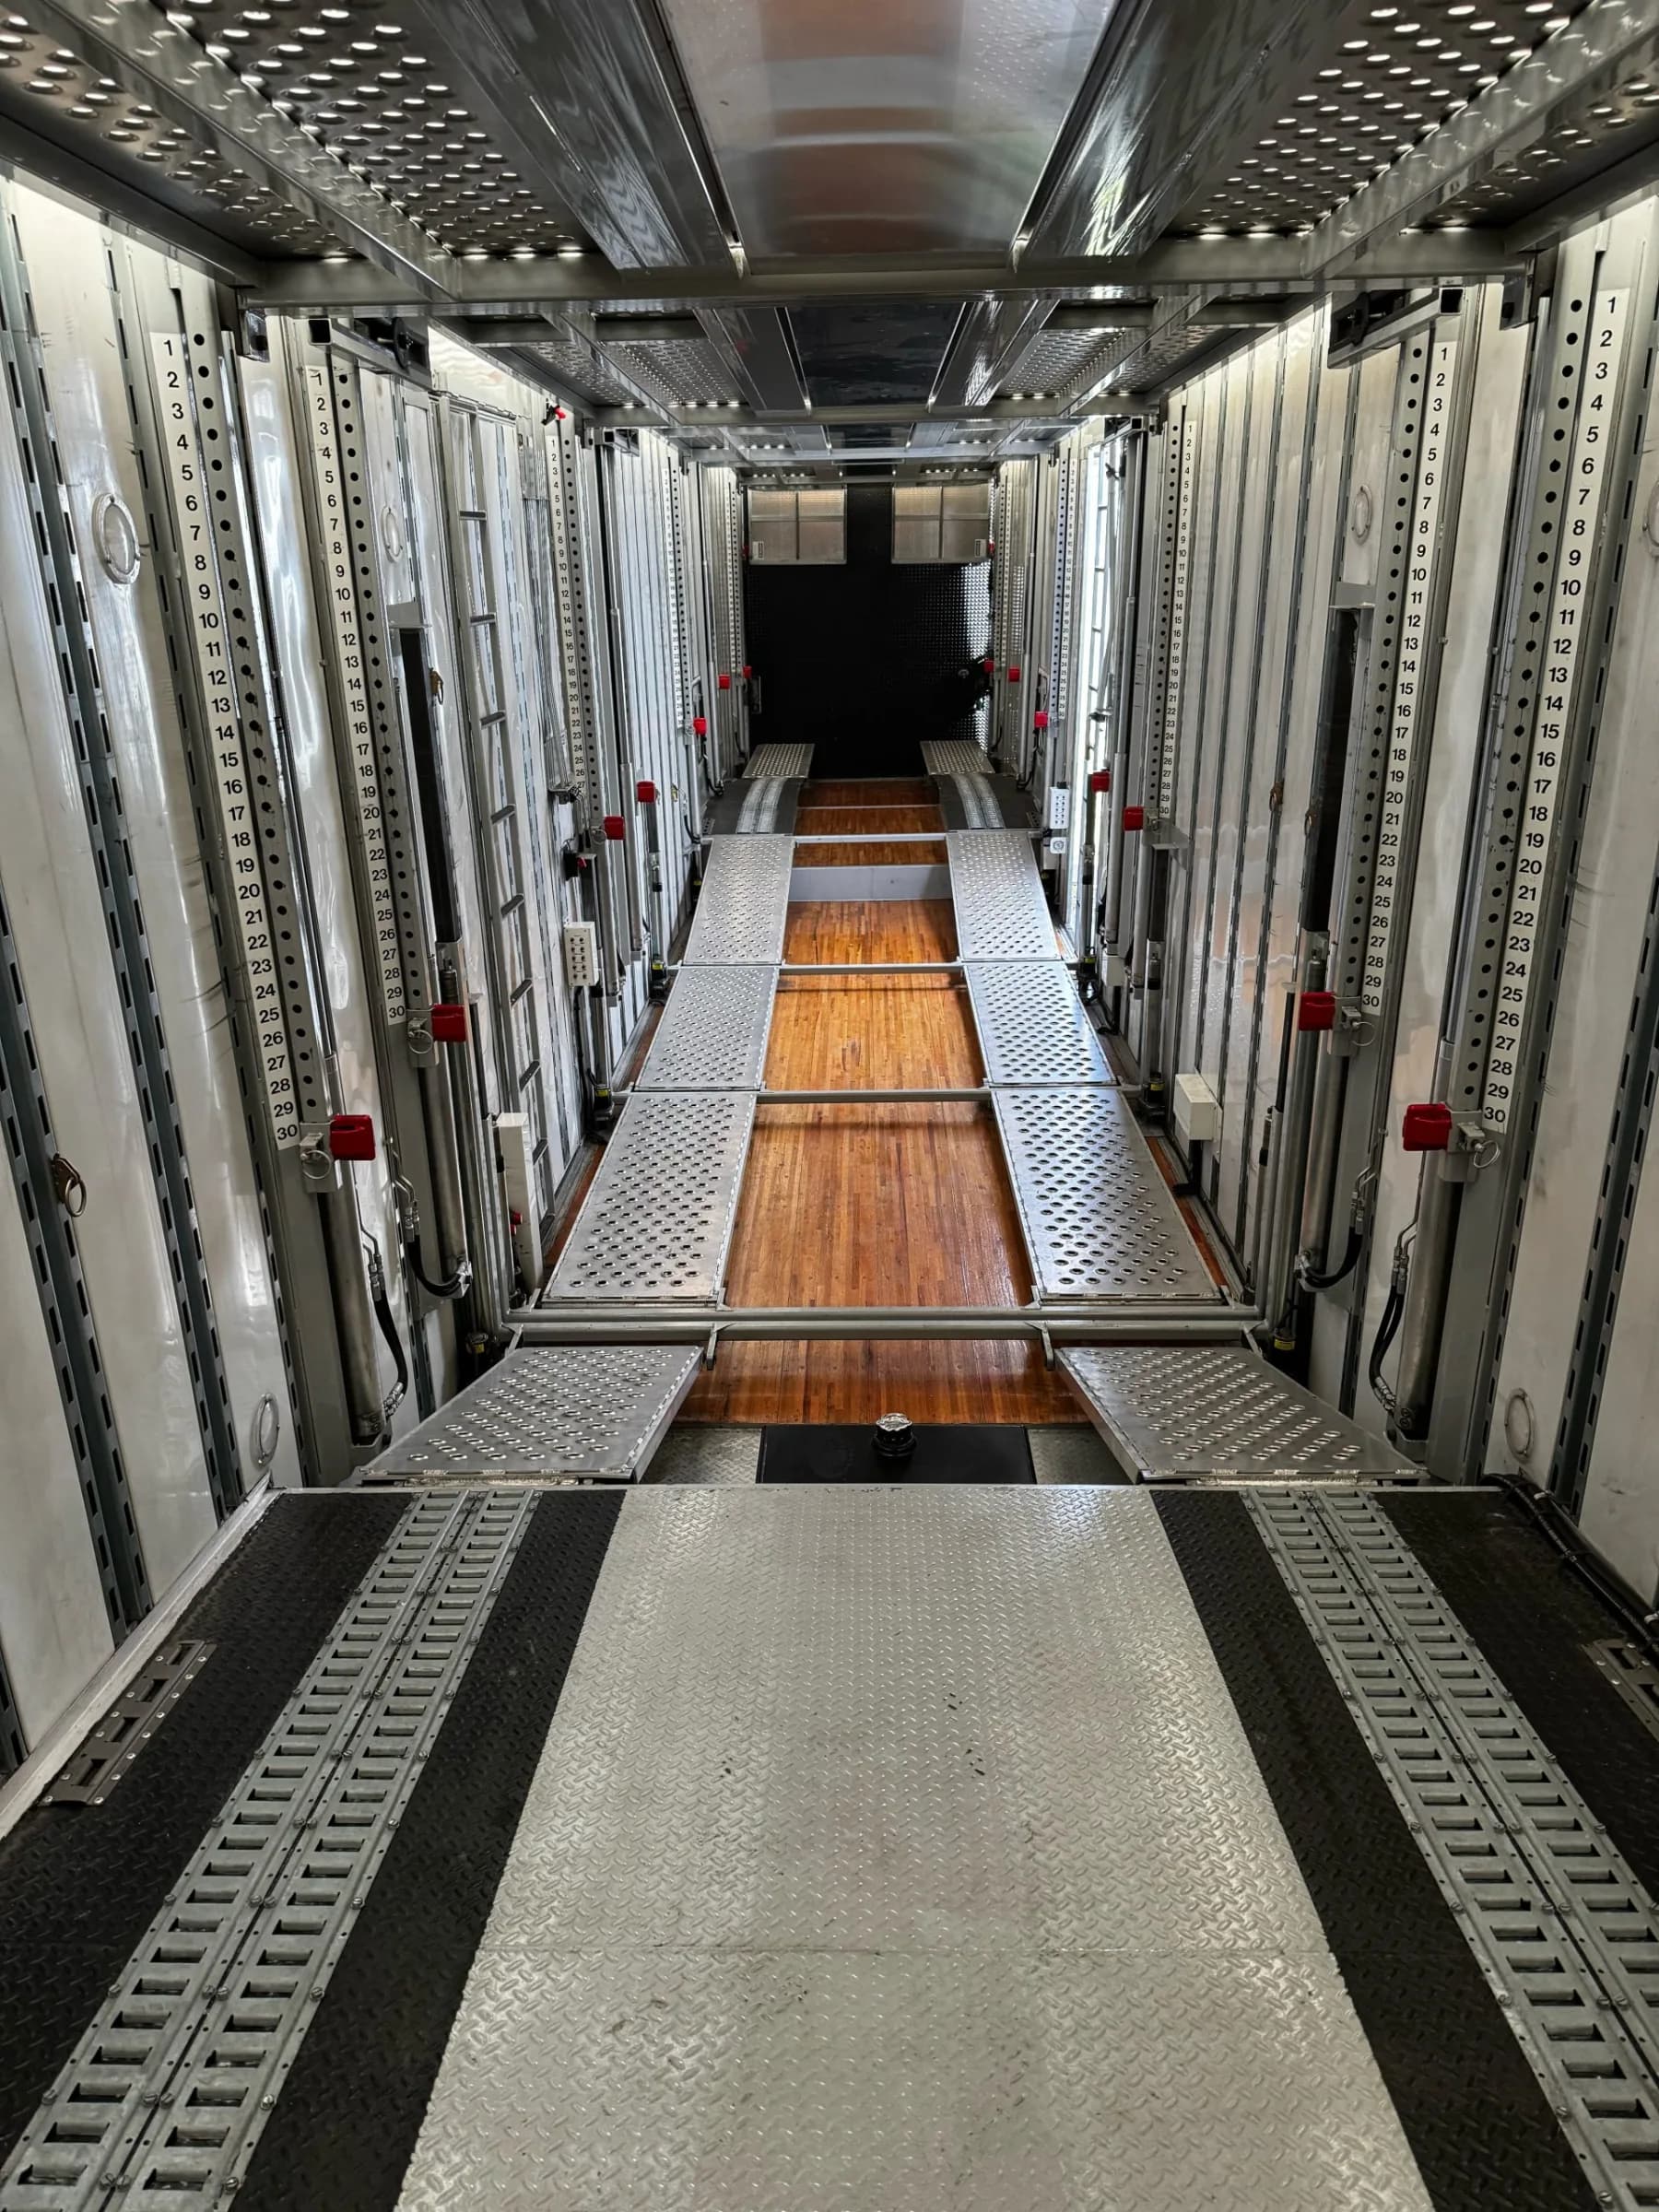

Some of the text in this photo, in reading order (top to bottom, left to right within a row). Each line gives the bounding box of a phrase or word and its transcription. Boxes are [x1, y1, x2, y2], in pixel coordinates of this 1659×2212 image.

[1608, 297, 1616, 314] 1
[1600, 330, 1612, 347] 2
[164, 340, 173, 356] 1
[1441, 347, 1447, 361] 1
[1595, 362, 1608, 379] 3
[167, 371, 179, 388] 2
[317, 373, 322, 386] 1
[1436, 373, 1445, 387] 2
[317, 397, 326, 411] 2
[1433, 398, 1442, 412] 3
[1591, 394, 1603, 411] 4
[172, 403, 184, 419] 3
[320, 422, 329, 435] 3
[1430, 423, 1439, 436] 4
[1586, 426, 1599, 443] 5
[177, 434, 189, 450] 4
[1187, 439, 1191, 447] 2
[322, 447, 331, 459] 4
[552, 453, 557, 461] 2
[1185, 453, 1191, 461] 3
[1428, 448, 1437, 461] 5
[182, 464, 193, 481] 5
[553, 467, 558, 475] 3
[1582, 458, 1594, 474] 6
[325, 470, 334, 483] 5
[1425, 472, 1434, 486] 6
[1184, 480, 1189, 489] 5
[186, 495, 198, 511] 6
[328, 494, 337, 507] 6
[555, 494, 560, 503] 5
[1423, 497, 1431, 509] 7
[1579, 489, 1590, 505] 7
[556, 508, 561, 517] 6
[330, 518, 338, 531] 7
[556, 522, 562, 530] 7
[1419, 520, 1428, 534] 8
[1573, 519, 1585, 536] 8
[190, 525, 200, 541] 7
[333, 541, 342, 554] 8
[1417, 544, 1426, 557] 9
[195, 555, 207, 571] 8
[1569, 549, 1581, 566] 9
[336, 565, 345, 578] 9
[559, 563, 567, 571] 10
[1412, 568, 1426, 581] 10
[199, 584, 210, 600] 9
[335, 588, 351, 600] 10
[1561, 579, 1581, 596] 10
[1411, 592, 1422, 604] 11
[562, 603, 570, 611] 13
[199, 613, 219, 629] 10
[340, 611, 352, 623] 11
[1407, 614, 1421, 627] 12
[1560, 609, 1574, 625] 11
[342, 633, 356, 646] 12
[1404, 637, 1418, 650] 13
[1553, 638, 1572, 654] 12
[206, 641, 221, 657] 11
[345, 656, 359, 668] 13
[1402, 660, 1415, 672] 14
[208, 670, 227, 685] 12
[1549, 667, 1567, 683] 13
[347, 678, 362, 690] 14
[1168, 681, 1178, 689] 20
[1399, 682, 1413, 695] 15
[211, 697, 230, 713] 13
[569, 694, 579, 702] 20
[1545, 695, 1563, 711] 14
[350, 700, 365, 712] 15
[1397, 705, 1411, 717] 16
[215, 725, 235, 740] 14
[353, 722, 368, 734] 16
[1395, 727, 1409, 739] 17
[1541, 723, 1559, 739] 15
[573, 731, 583, 740] 23
[356, 743, 369, 756] 17
[1392, 749, 1406, 761] 18
[219, 752, 239, 767] 15
[1537, 752, 1556, 767] 16
[359, 765, 373, 777] 18
[1390, 770, 1404, 782] 19
[223, 779, 243, 794] 16
[362, 786, 376, 798] 19
[1534, 779, 1552, 794] 17
[1386, 791, 1403, 804] 20
[228, 806, 245, 821] 17
[364, 807, 379, 819] 20
[1385, 813, 1399, 825] 21
[1529, 806, 1548, 821] 18
[232, 832, 251, 847] 18
[368, 828, 381, 840] 21
[1381, 833, 1398, 847] 22
[1526, 833, 1544, 848] 19
[369, 848, 386, 861] 22
[1379, 854, 1395, 867] 23
[236, 858, 254, 873] 19
[1519, 859, 1542, 875] 20
[372, 869, 388, 881] 23
[1376, 875, 1393, 887] 24
[238, 883, 260, 900] 20
[375, 889, 391, 901] 24
[1518, 885, 1536, 901] 21
[1374, 895, 1390, 908] 25
[245, 909, 262, 925] 21
[377, 909, 393, 921] 25
[1371, 915, 1388, 928] 26
[1512, 911, 1534, 927] 22
[379, 928, 396, 941] 26
[1370, 935, 1386, 948] 27
[247, 934, 268, 950] 22
[1508, 936, 1530, 952] 23
[382, 948, 397, 961] 27
[1367, 955, 1383, 968] 28
[252, 959, 272, 975] 23
[385, 967, 400, 979] 28
[1505, 961, 1526, 977] 24
[1365, 975, 1381, 988] 29
[255, 983, 276, 1000] 24
[387, 986, 402, 1000] 29
[1501, 986, 1523, 1002] 25
[1362, 995, 1379, 1008] 30
[259, 1007, 280, 1024] 25
[389, 1005, 405, 1018] 30
[1498, 1011, 1519, 1027] 26
[263, 1031, 284, 1047] 26
[1495, 1035, 1516, 1051] 27
[267, 1055, 285, 1071] 27
[1491, 1059, 1512, 1075] 28
[270, 1078, 291, 1095] 28
[1487, 1083, 1509, 1099] 29
[274, 1101, 294, 1118] 29
[1483, 1106, 1506, 1123] 30
[277, 1124, 298, 1140] 30
